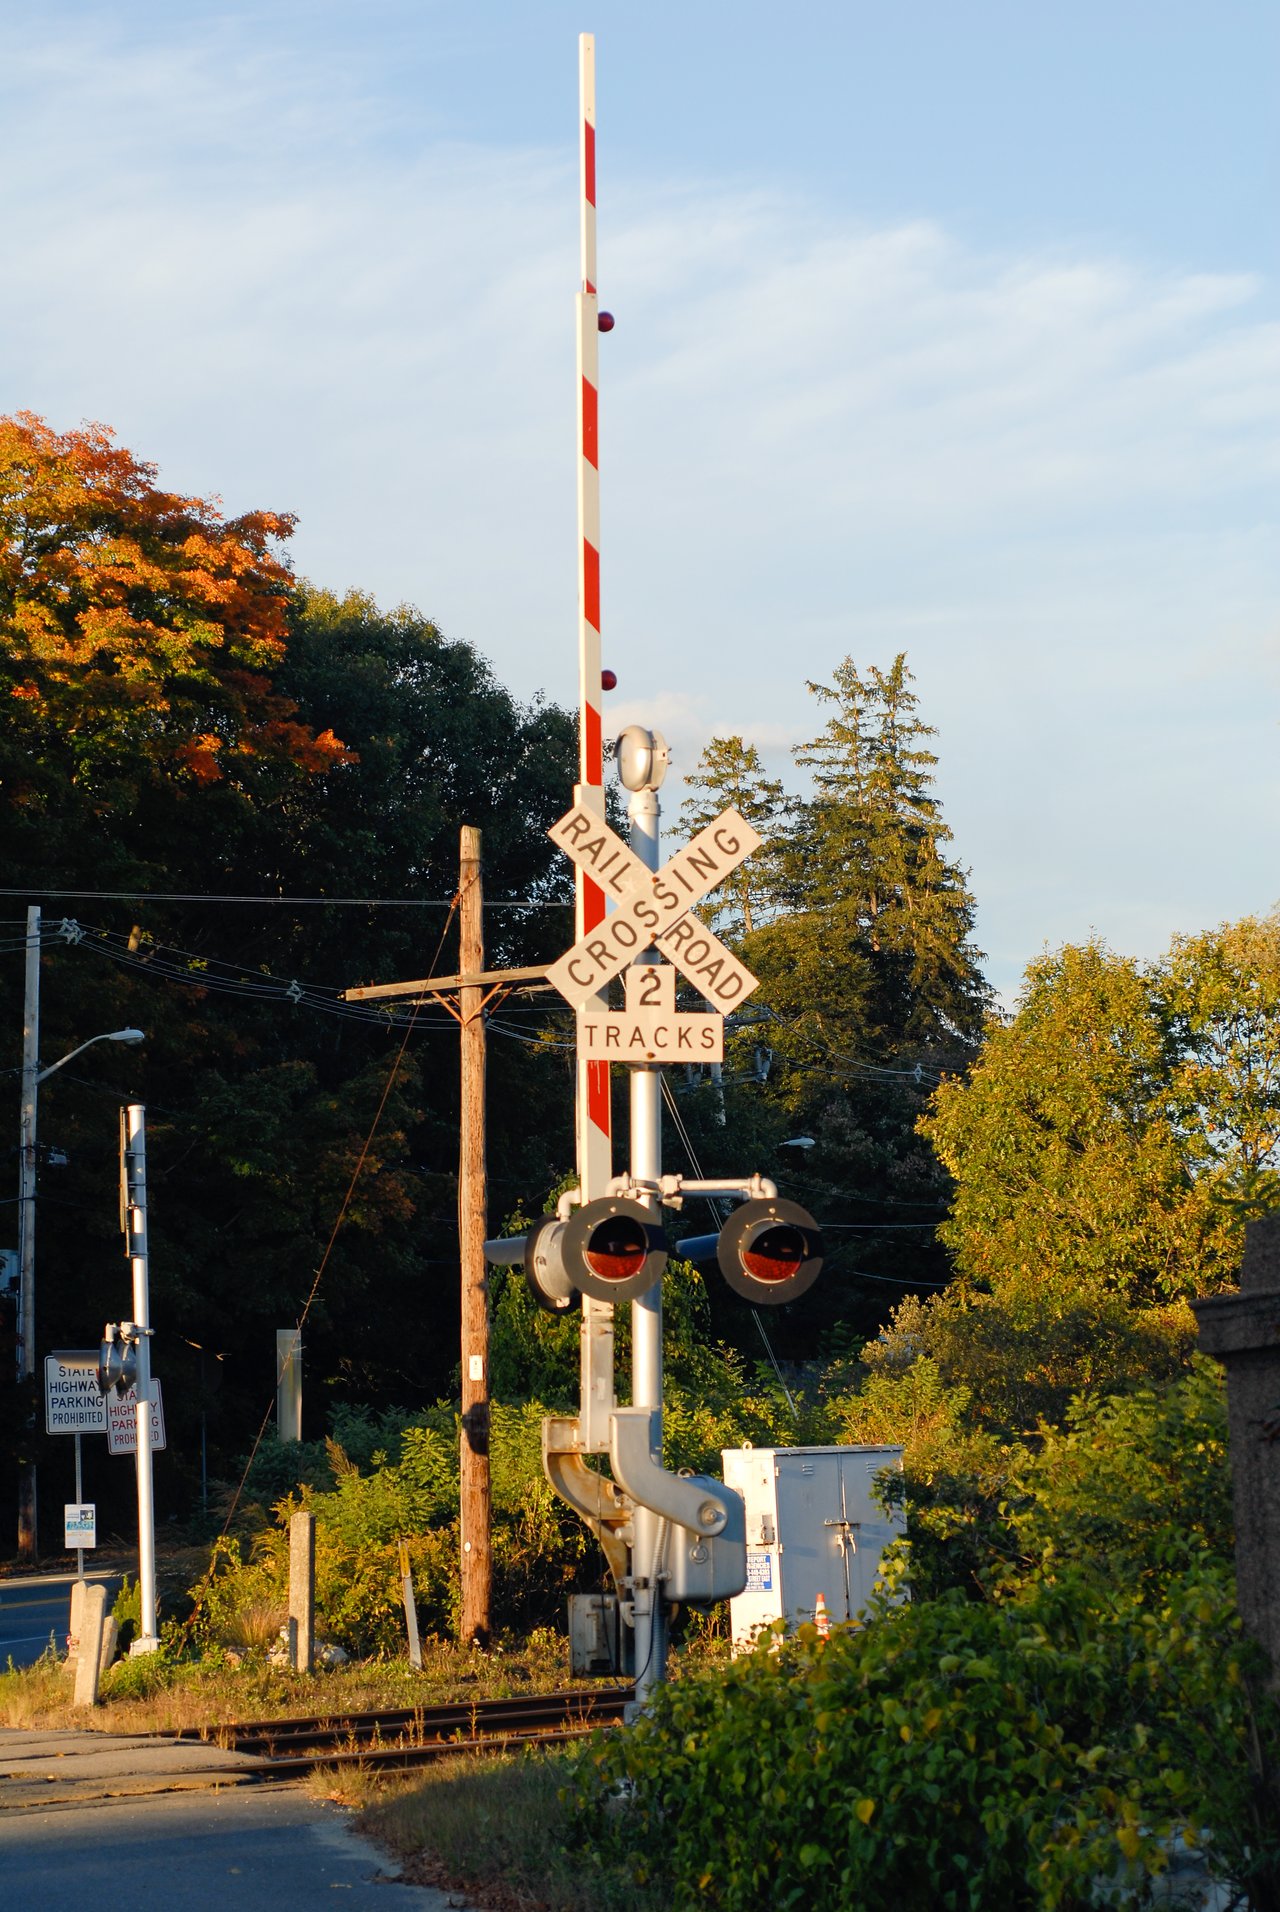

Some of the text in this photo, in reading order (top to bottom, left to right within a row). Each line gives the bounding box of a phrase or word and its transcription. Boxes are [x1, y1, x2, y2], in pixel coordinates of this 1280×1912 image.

[560, 813, 631, 893] RAIL
[568, 828, 740, 986] CROSSING
[664, 919, 743, 999] ROAD
[639, 973, 662, 1006] 2
[584, 1025, 715, 1049] TRACKS
[51, 1396, 103, 1408] PARKING
[109, 1402, 157, 1416] HIGHY
[53, 1412, 103, 1424] PROHIBITED
